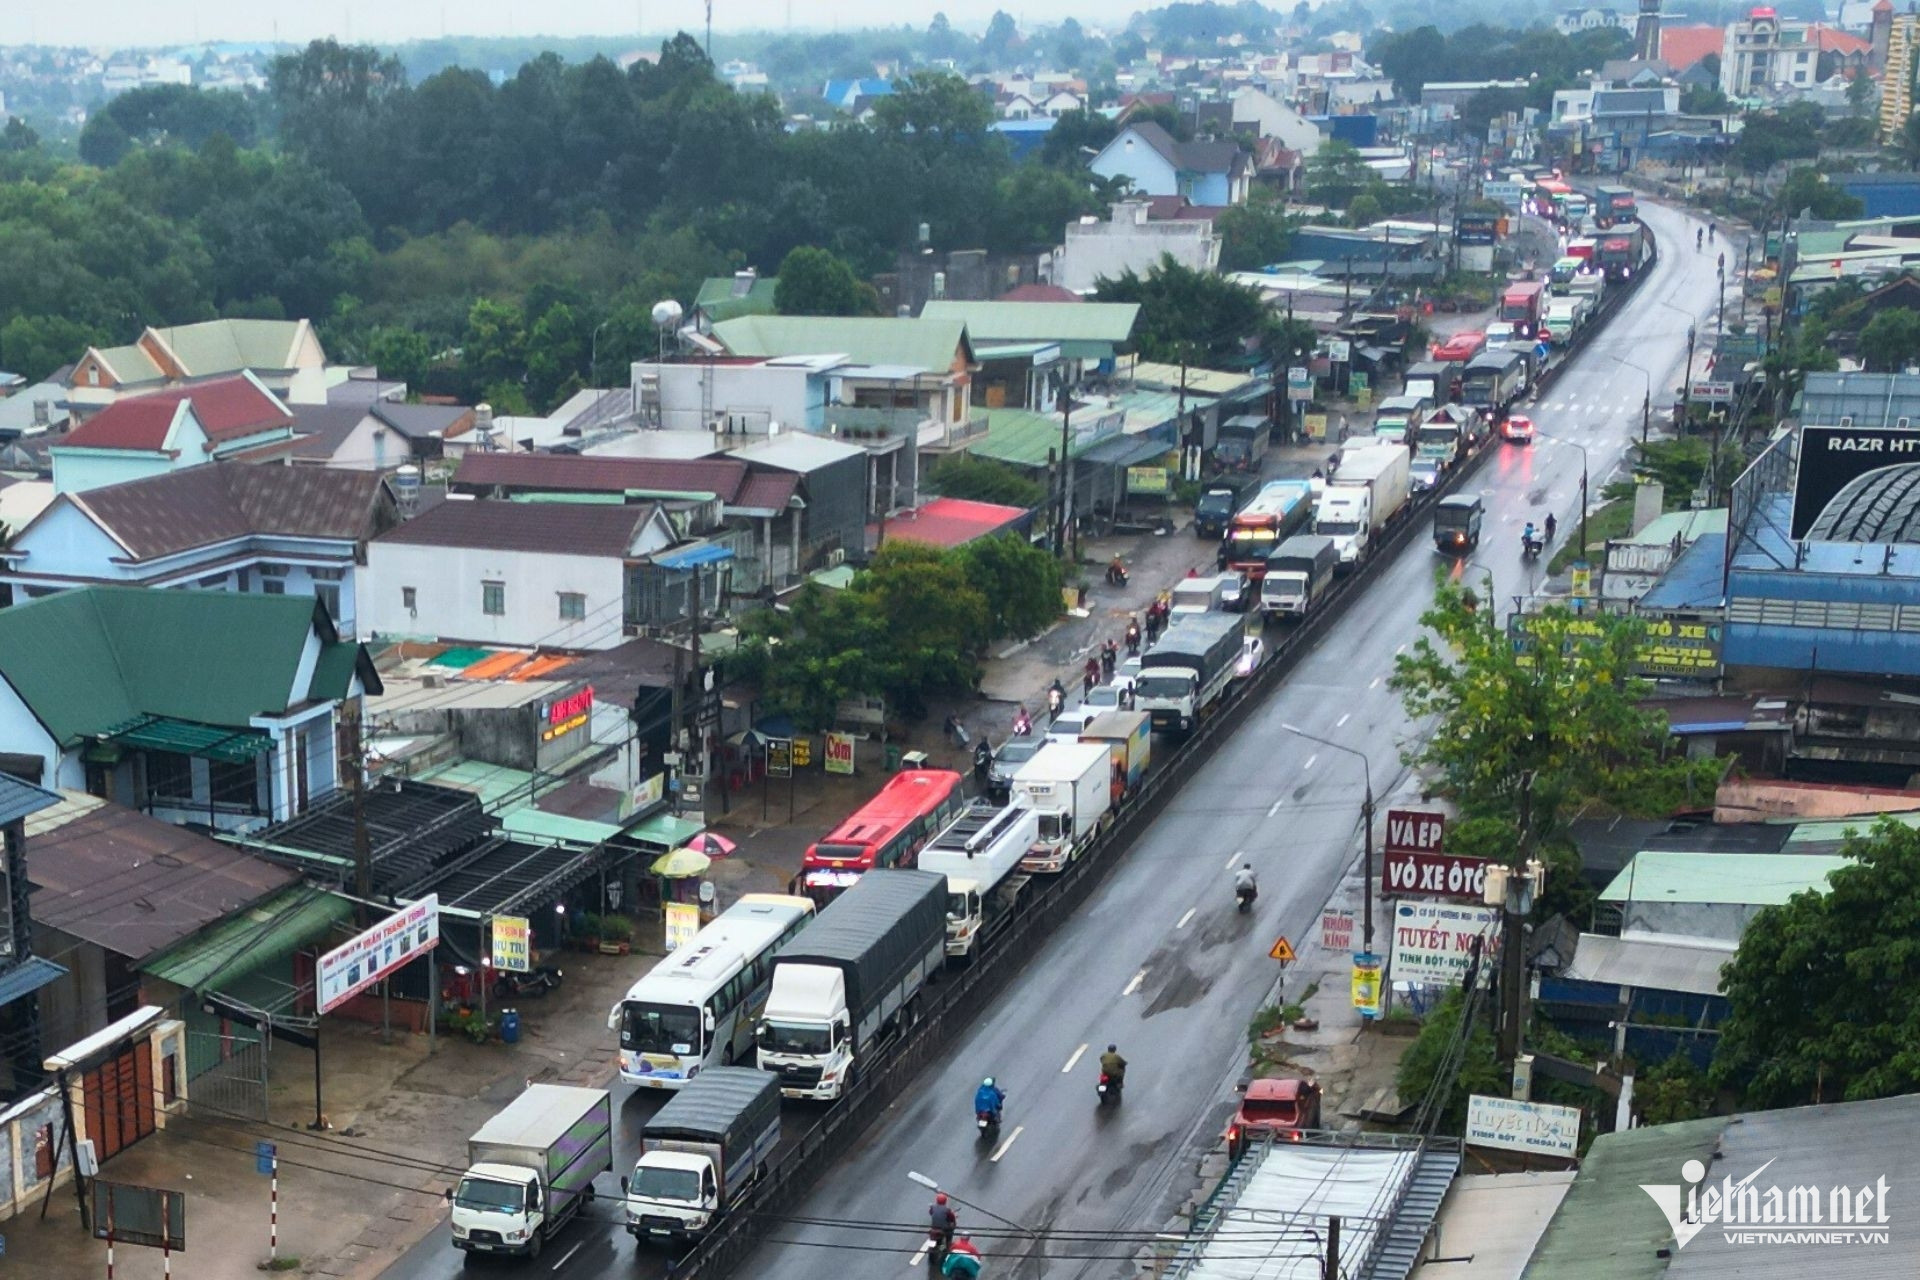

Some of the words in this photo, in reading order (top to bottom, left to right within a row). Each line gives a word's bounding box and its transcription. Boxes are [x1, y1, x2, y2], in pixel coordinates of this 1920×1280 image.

[1827, 437, 1884, 452] RAZR
[1390, 816, 1415, 846] VÁ
[1389, 856, 1417, 889] VỎ
[1419, 864, 1445, 891] XE
[1398, 919, 1450, 951] TUYẾT
